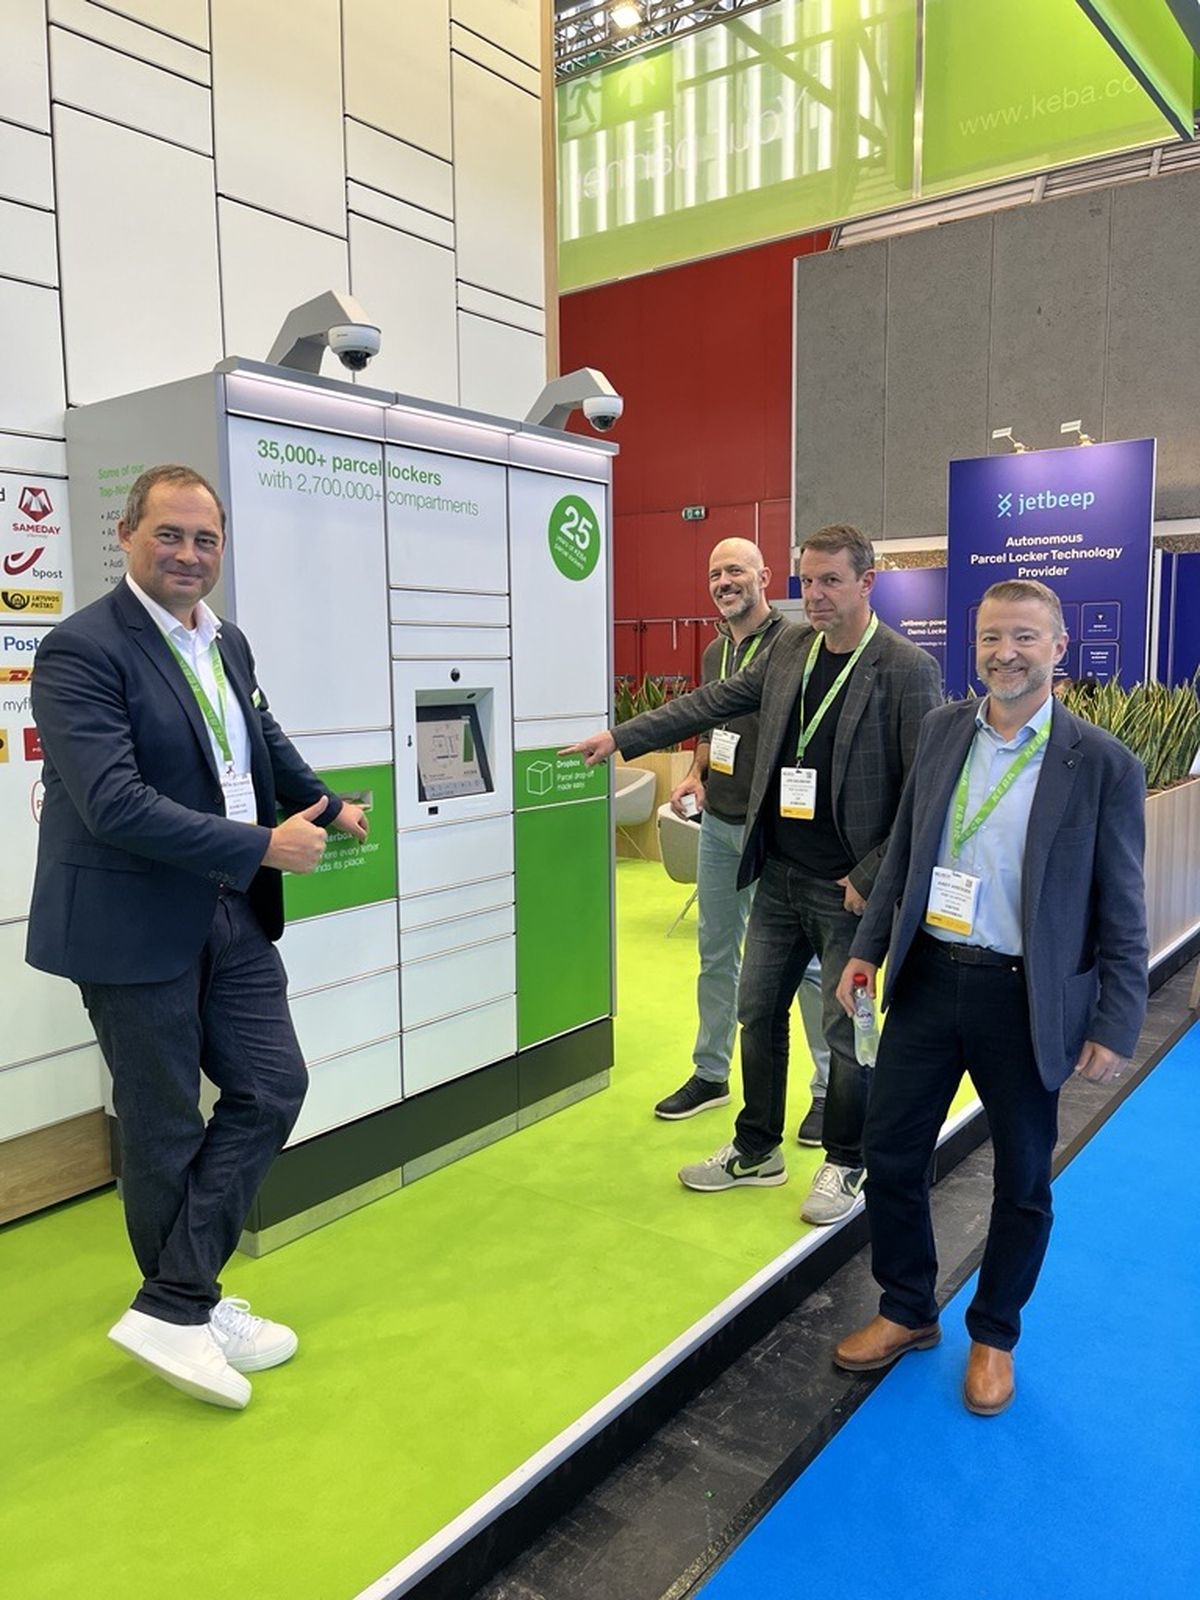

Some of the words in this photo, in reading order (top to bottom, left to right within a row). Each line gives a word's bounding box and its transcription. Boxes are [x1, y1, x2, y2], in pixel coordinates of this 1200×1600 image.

[257, 438, 327, 467] 35,000+
[332, 454, 382, 477] parcel
[387, 461, 442, 486] lockers
[258, 469, 292, 490] with
[297, 472, 382, 501] 2,700,000+
[388, 488, 479, 517] compartments
[1018, 490, 1095, 515] jetbeep
[12, 523, 61, 535] SAMEDAY
[560, 505, 593, 550] 25
[1006, 533, 1084, 548] Autonomous
[970, 553, 1007, 565] Parcel
[1009, 550, 1049, 563] Locker
[1050, 546, 1123, 561] Technology
[32, 567, 63, 580] bpost
[1018, 566, 1069, 578] Provider
[989, 770, 1015, 802] KEBA
[339, 847, 359, 857] every
